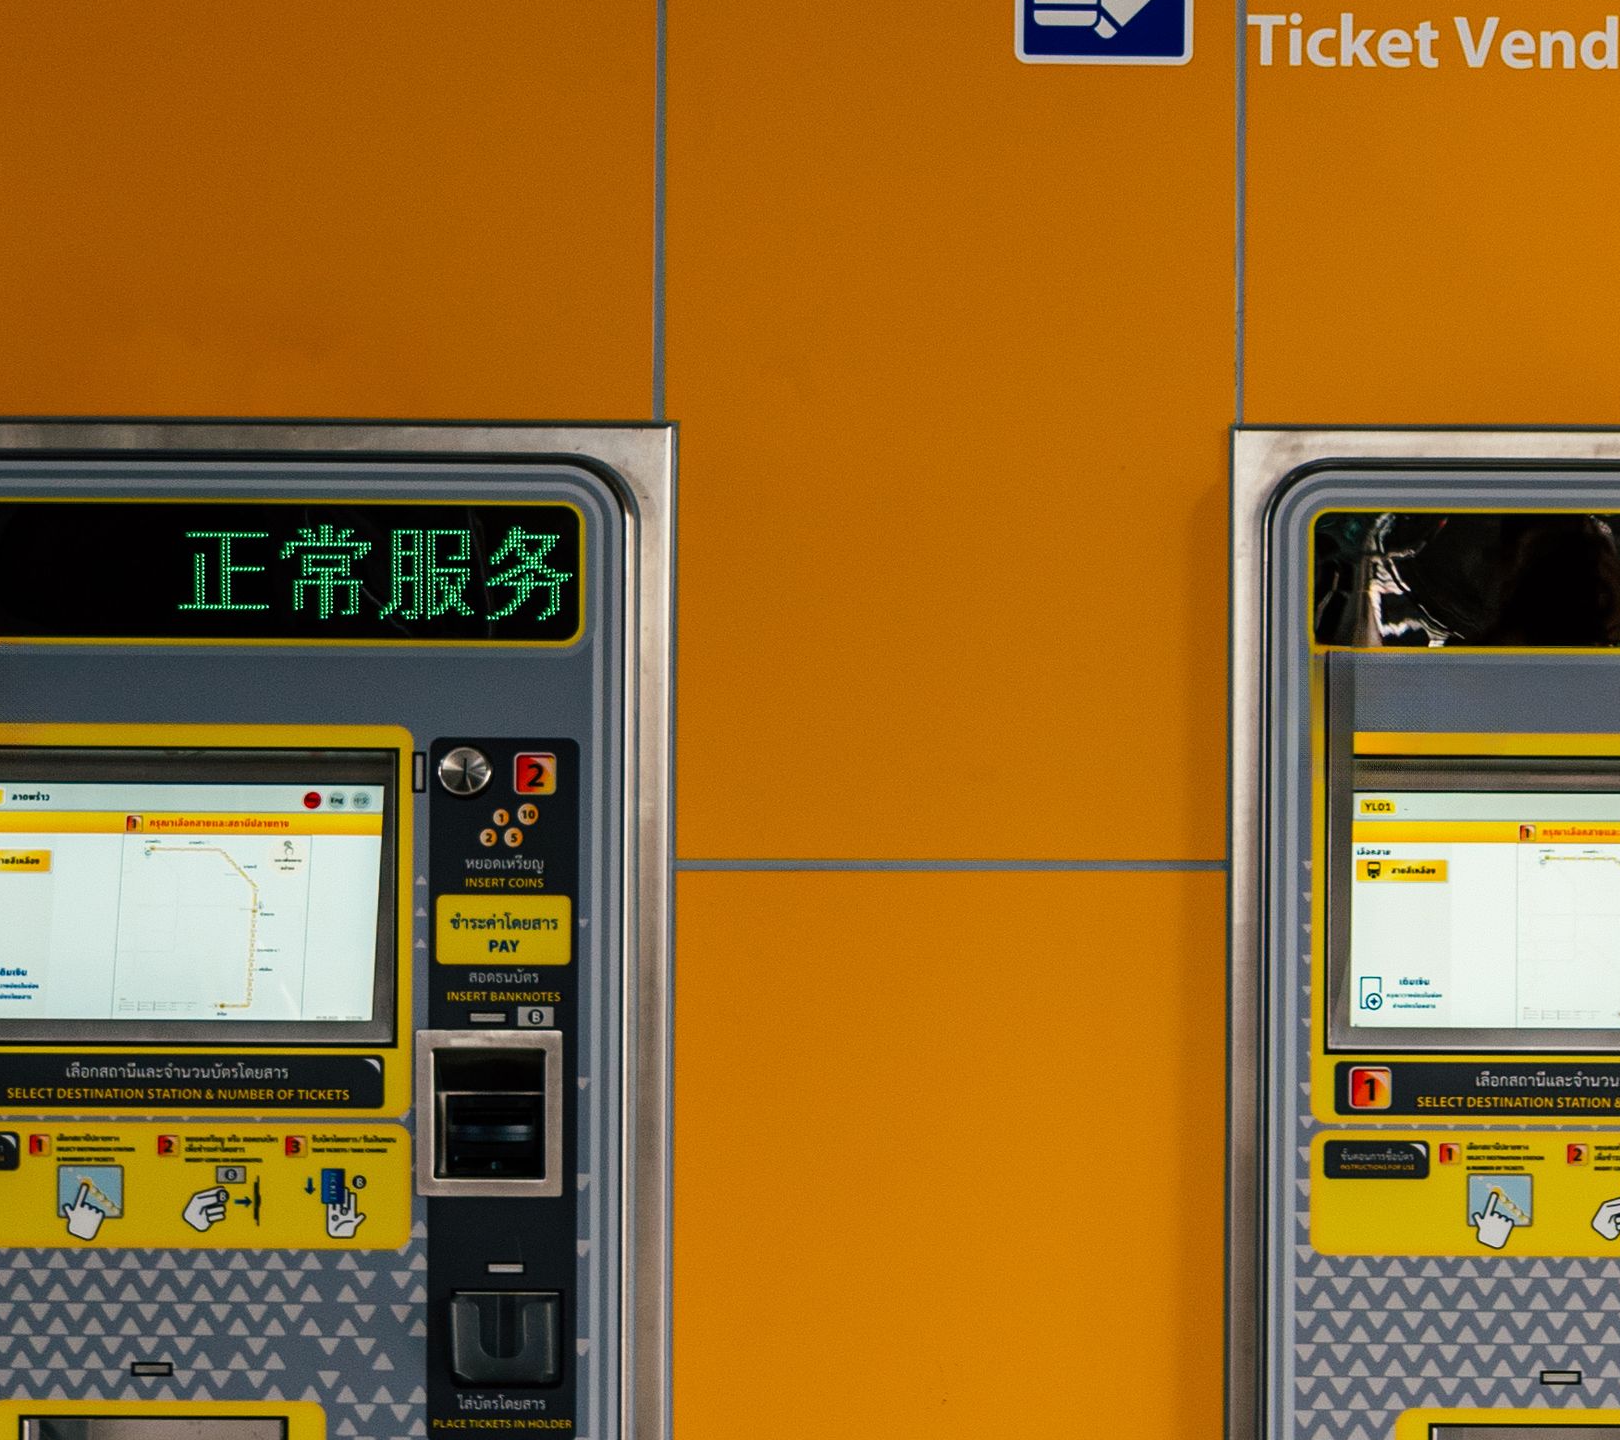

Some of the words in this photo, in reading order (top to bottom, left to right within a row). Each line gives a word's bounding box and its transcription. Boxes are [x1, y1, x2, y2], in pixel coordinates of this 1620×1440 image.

[1247, 15, 1439, 71] Ticket
[178, 523, 572, 622] 正常服务
[527, 764, 544, 787] 2
[330, 796, 344, 806] Eng
[1364, 803, 1391, 812] YL01
[465, 856, 545, 874] หยอดเหรียญ
[465, 878, 506, 888] INSERT
[508, 878, 544, 888] COINS
[450, 912, 558, 930] ชำระค่าโดยสาร
[488, 940, 520, 953] PAY
[469, 968, 539, 983] สอดธนบัตร
[447, 991, 488, 1001] INSERT
[490, 991, 561, 1002] BANKNOTES
[65, 1061, 289, 1081] เลือกสถานีและจำนวนบัตรโดยสาร
[6, 1087, 54, 1099] SELECT
[56, 1088, 144, 1099] DESTINATION
[147, 1088, 202, 1100] STATION
[205, 1089, 214, 1100] &
[217, 1089, 274, 1100] NUMBER
[277, 1089, 295, 1100] OF
[297, 1089, 350, 1101] TICKETS
[1364, 1076, 1377, 1101] 1
[1415, 1096, 1463, 1108] SELECT
[1465, 1097, 1553, 1108] DESTINATION
[1556, 1097, 1611, 1109] STATION
[162, 1140, 174, 1155] 2
[290, 1140, 301, 1155] 3
[1571, 1149, 1583, 1164] 2
[456, 1393, 547, 1410] ใส่บัตรโดยสาร
[432, 1418, 467, 1428] PLACE
[469, 1419, 512, 1429] TICKETS
[513, 1419, 525, 1429] IN
[528, 1419, 572, 1429] HOLDER
